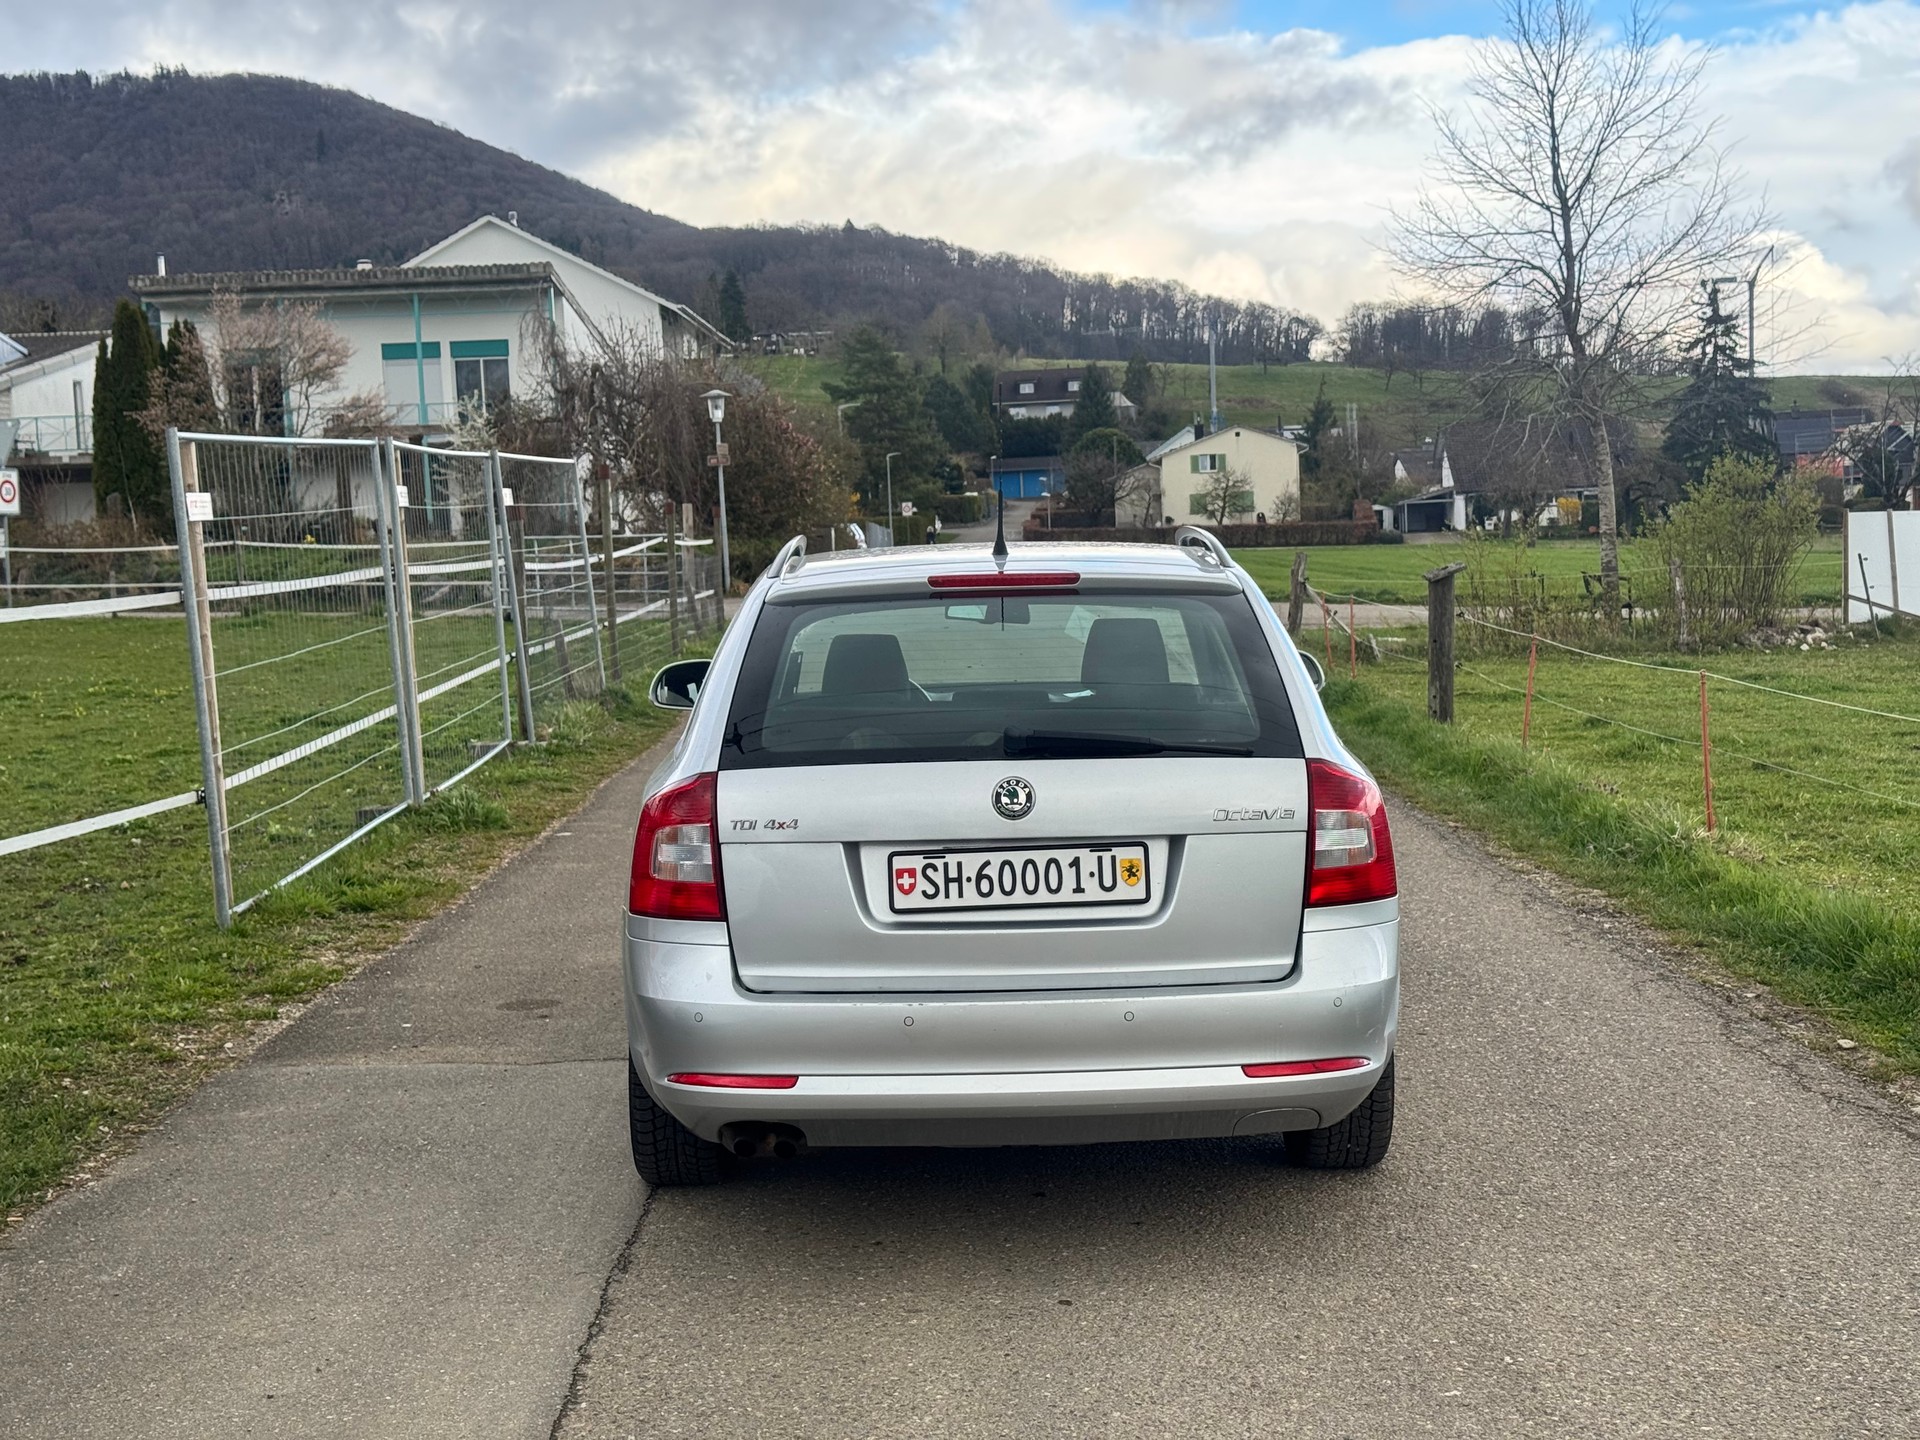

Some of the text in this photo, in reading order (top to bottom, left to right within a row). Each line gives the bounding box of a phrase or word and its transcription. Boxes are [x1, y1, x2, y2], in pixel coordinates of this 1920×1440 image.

[1212, 806, 1296, 822] Octavia
[730, 818, 799, 831] TDI 4x4
